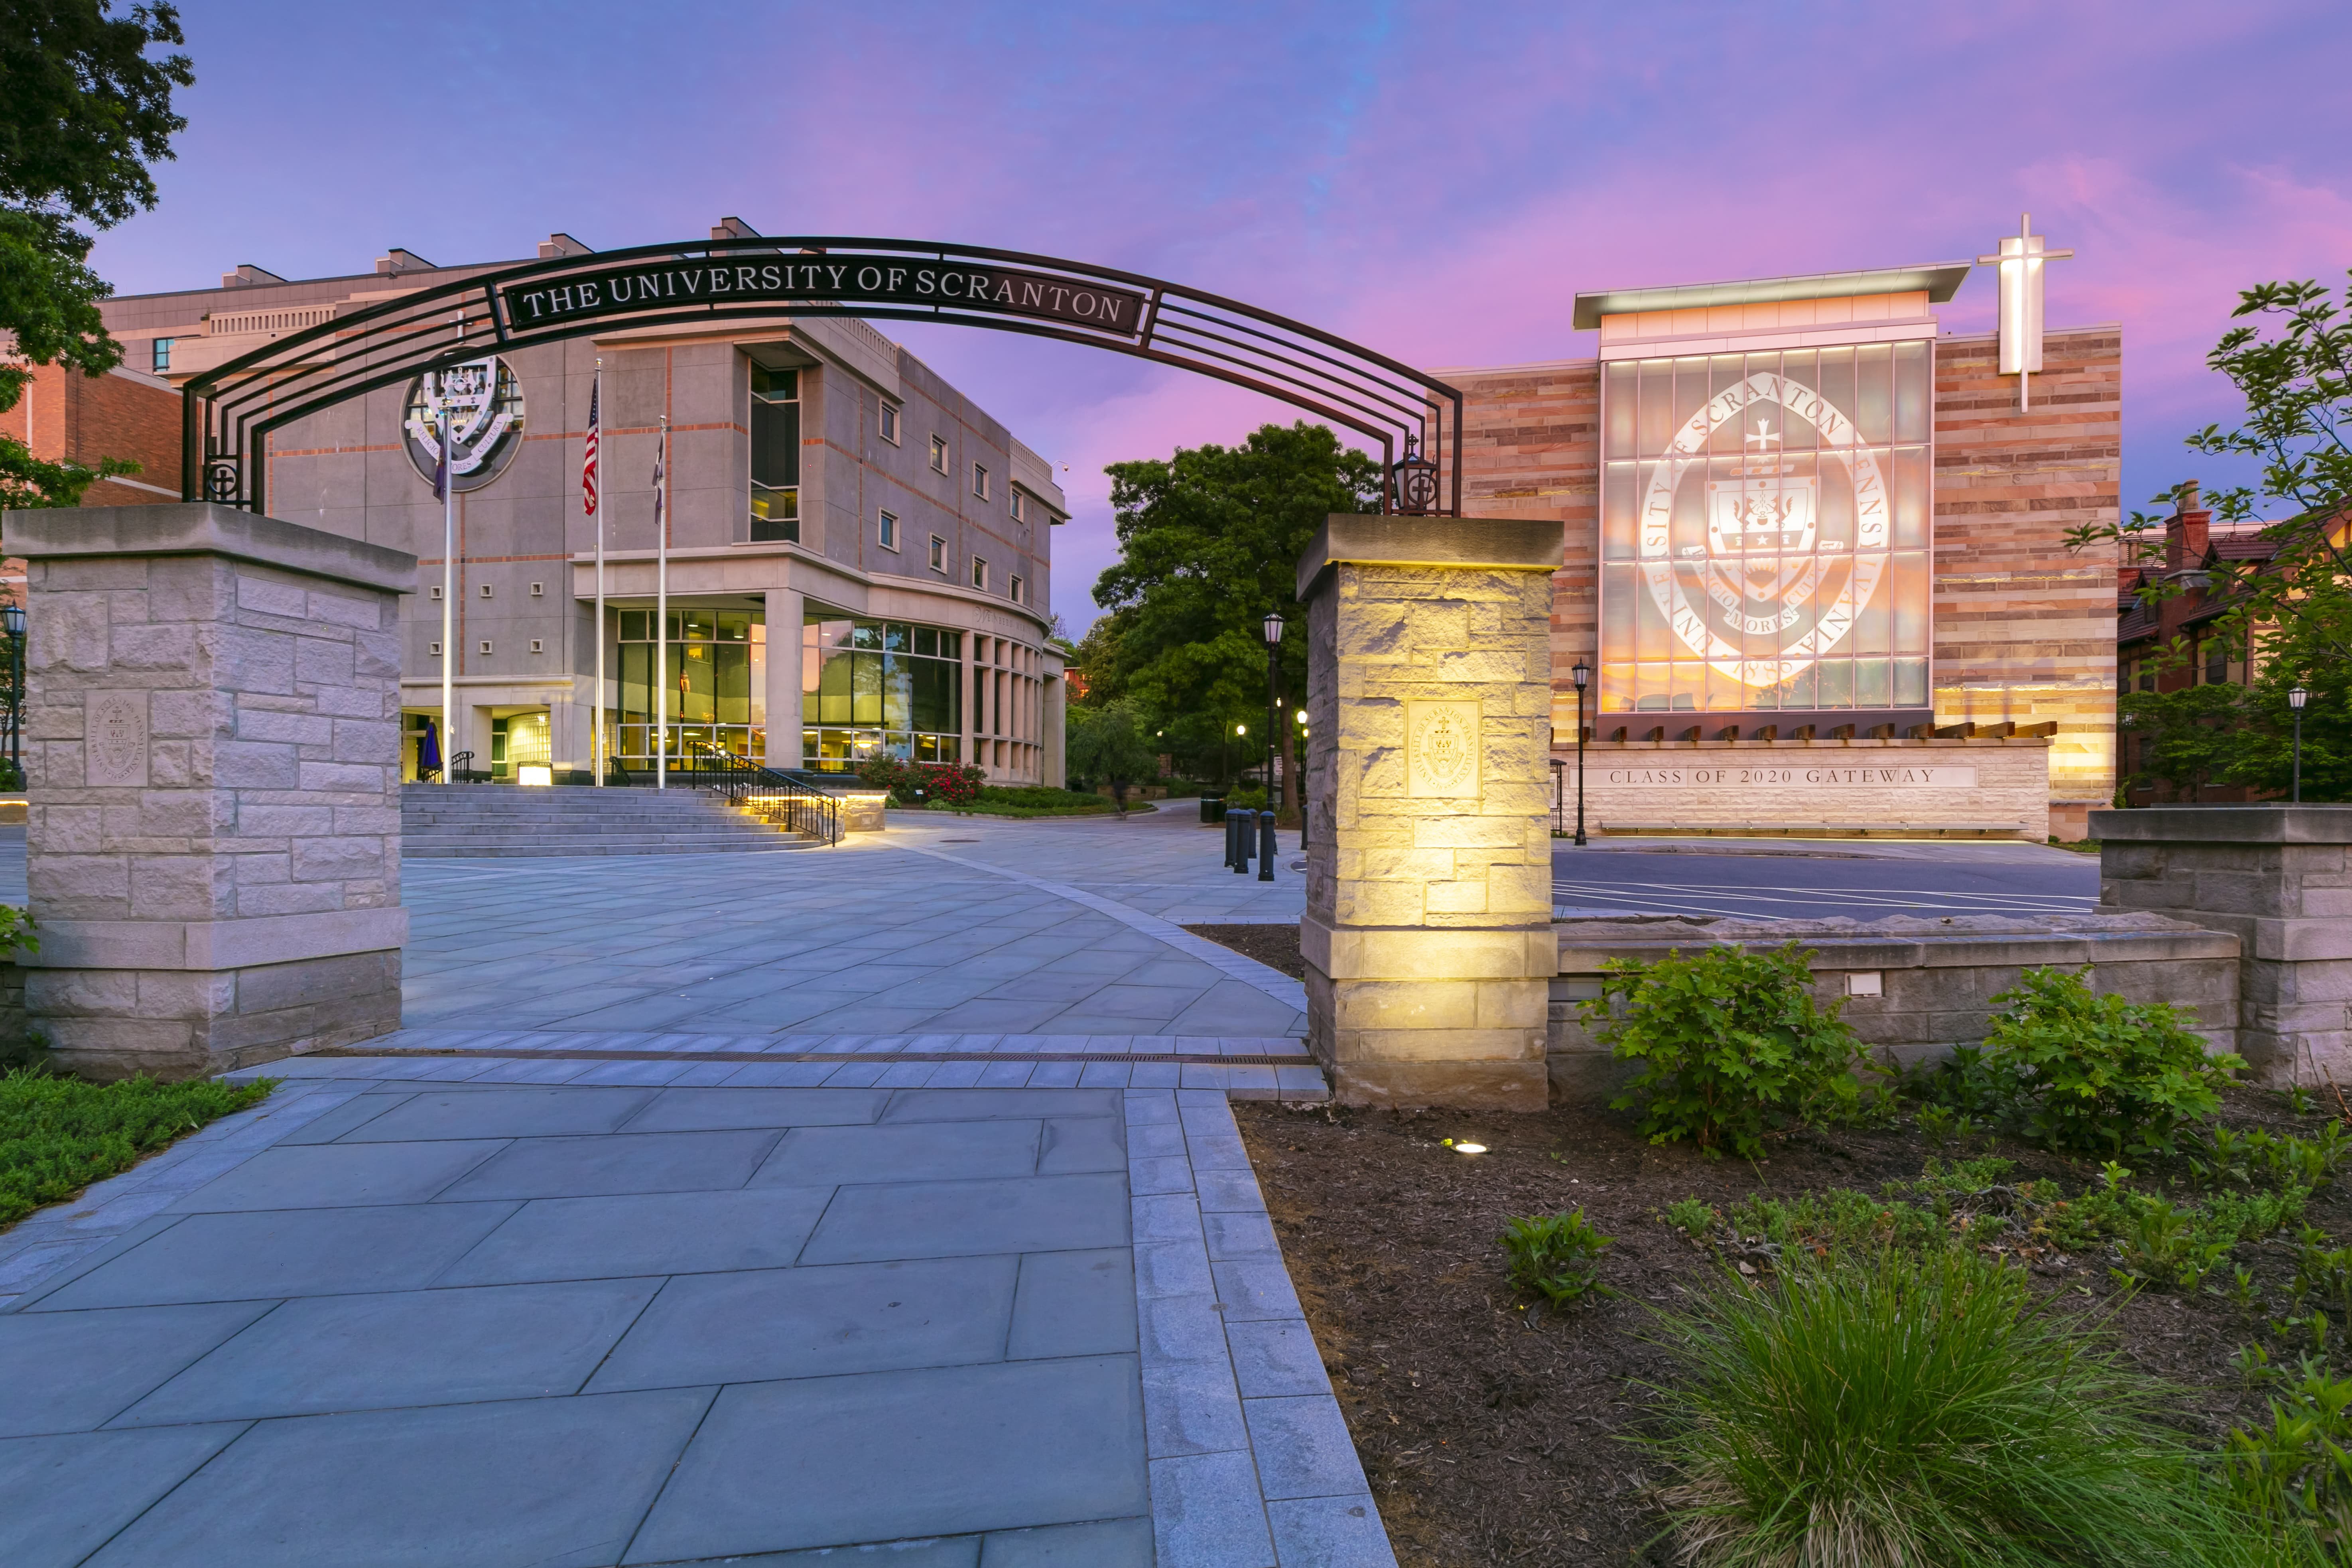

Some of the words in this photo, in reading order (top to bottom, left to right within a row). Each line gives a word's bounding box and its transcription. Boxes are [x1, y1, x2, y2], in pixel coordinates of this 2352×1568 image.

[523, 282, 600, 318] THE
[608, 265, 847, 303] UNIVERSITY
[857, 266, 907, 292] OF
[916, 269, 1123, 322] SCRANTON
[416, 426, 439, 455] RELIGIO
[451, 462, 472, 471] ORES
[477, 421, 502, 453] CULTURA
[1647, 481, 1714, 654] UNIVESITY
[1691, 376, 1845, 437] SCRANTON
[1798, 438, 1882, 653] ENNSYLVANIA
[1729, 611, 1793, 632] MORES
[1787, 543, 1834, 605] CULTUA
[1610, 770, 1681, 783] CLASS
[1695, 770, 1726, 783] OF
[1740, 770, 1791, 783] 2020
[1806, 769, 1934, 783] GATEWAY
